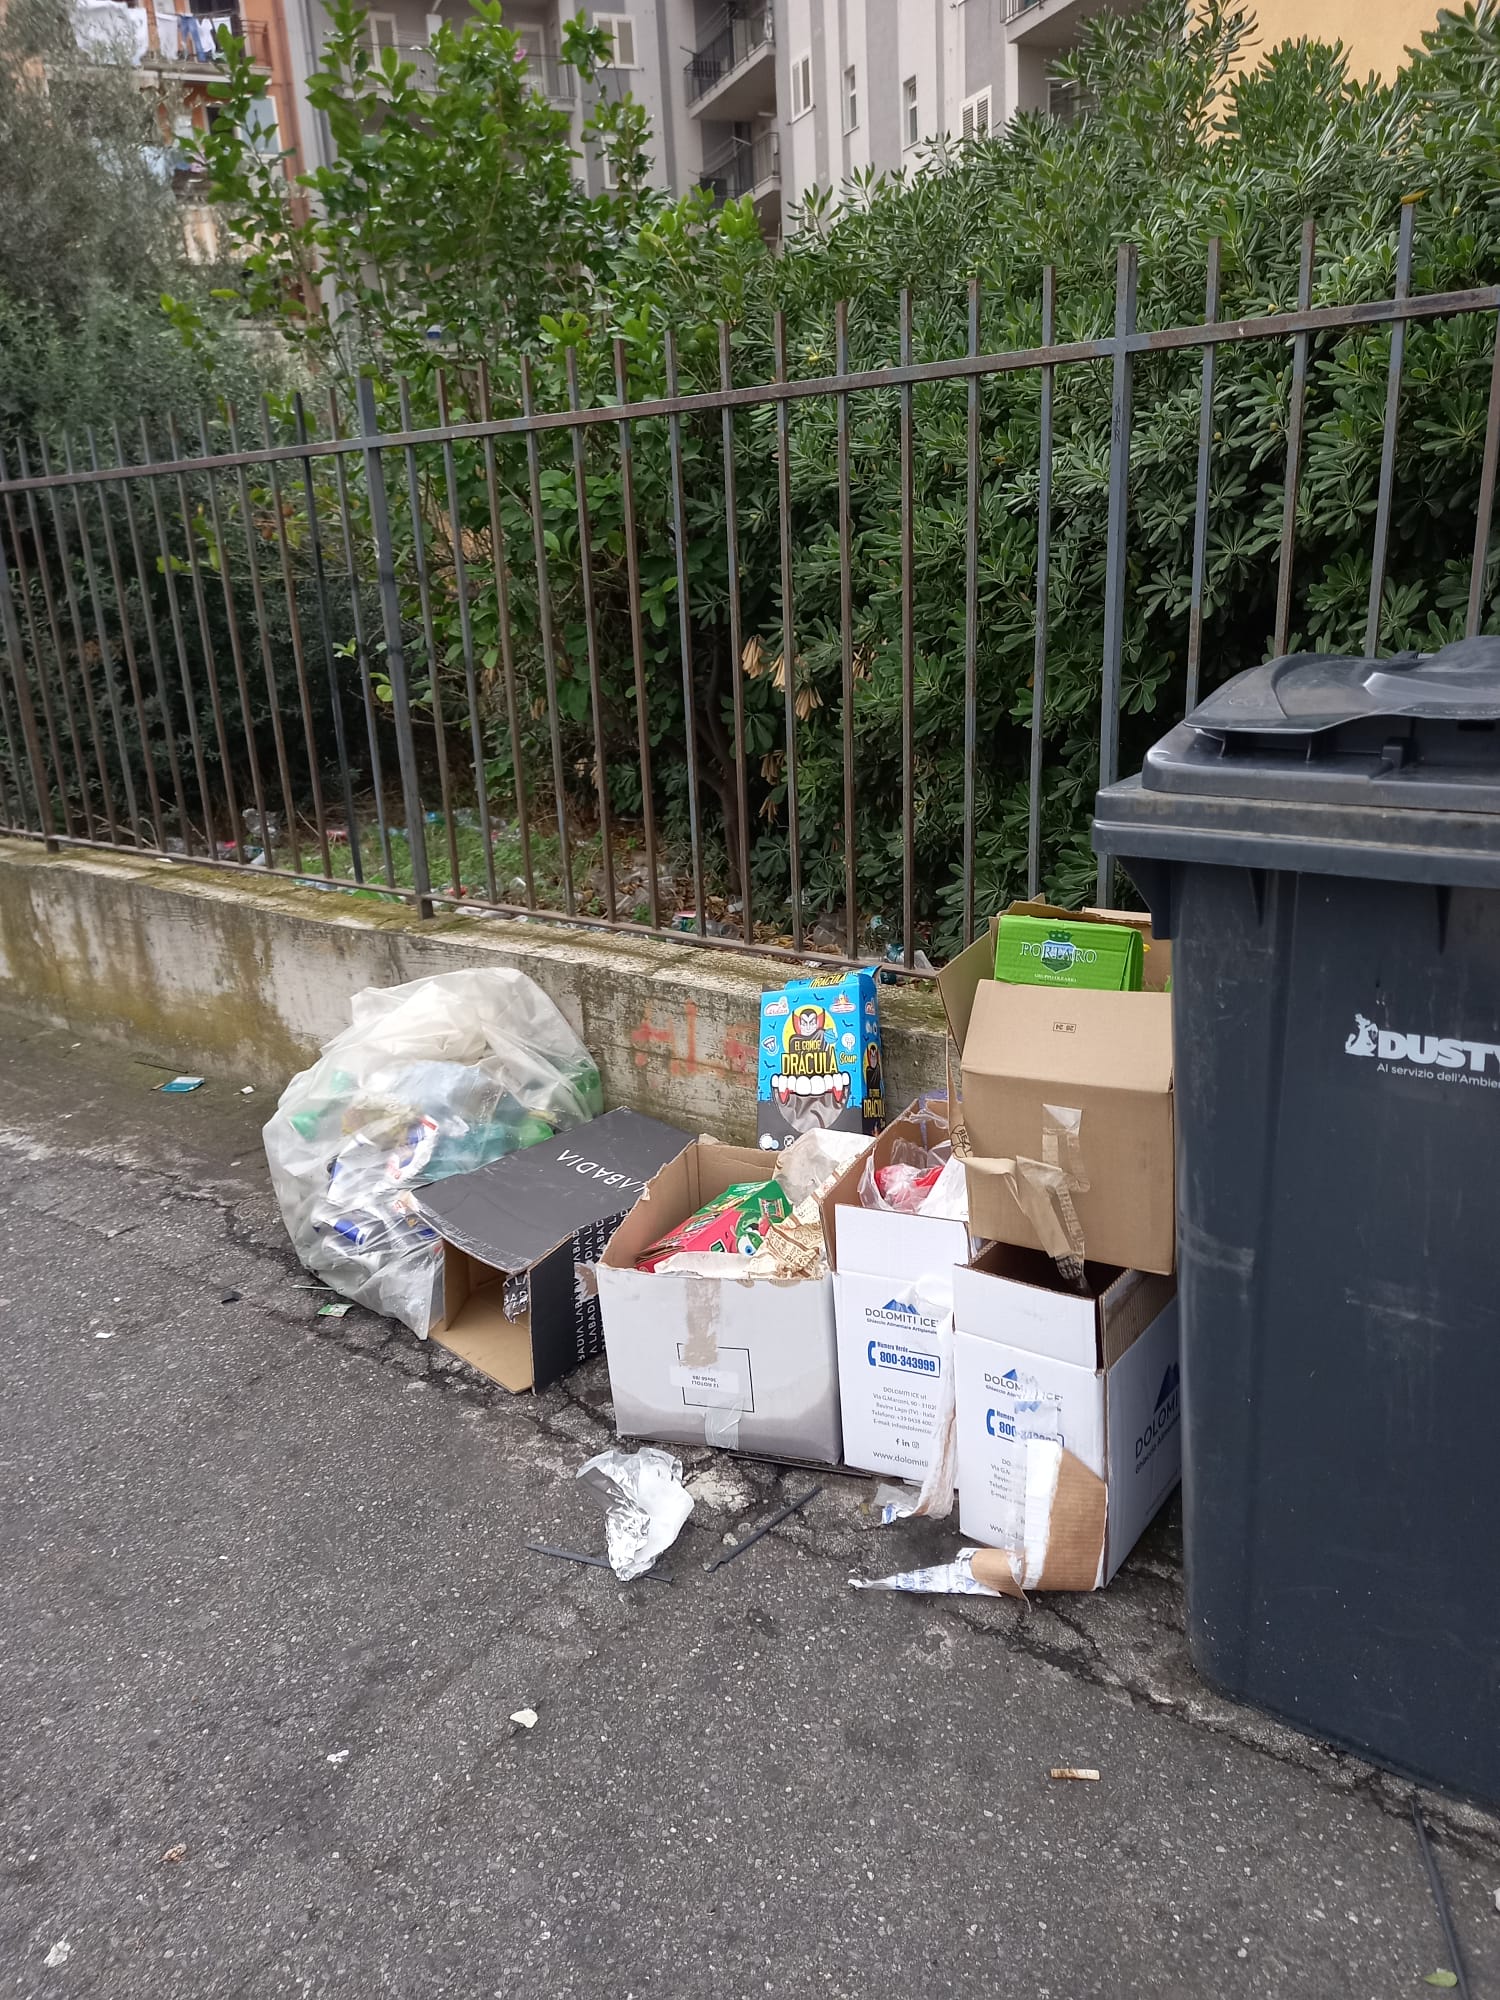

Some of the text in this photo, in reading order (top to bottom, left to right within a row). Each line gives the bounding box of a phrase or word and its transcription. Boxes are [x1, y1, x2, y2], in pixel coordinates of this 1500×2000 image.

[1377, 1063, 1389, 1073] Al
[1391, 1065, 1434, 1079] servizio
[865, 1308, 937, 1328] DOLOMITI ICE
[879, 1351, 935, 1372] 800-343999
